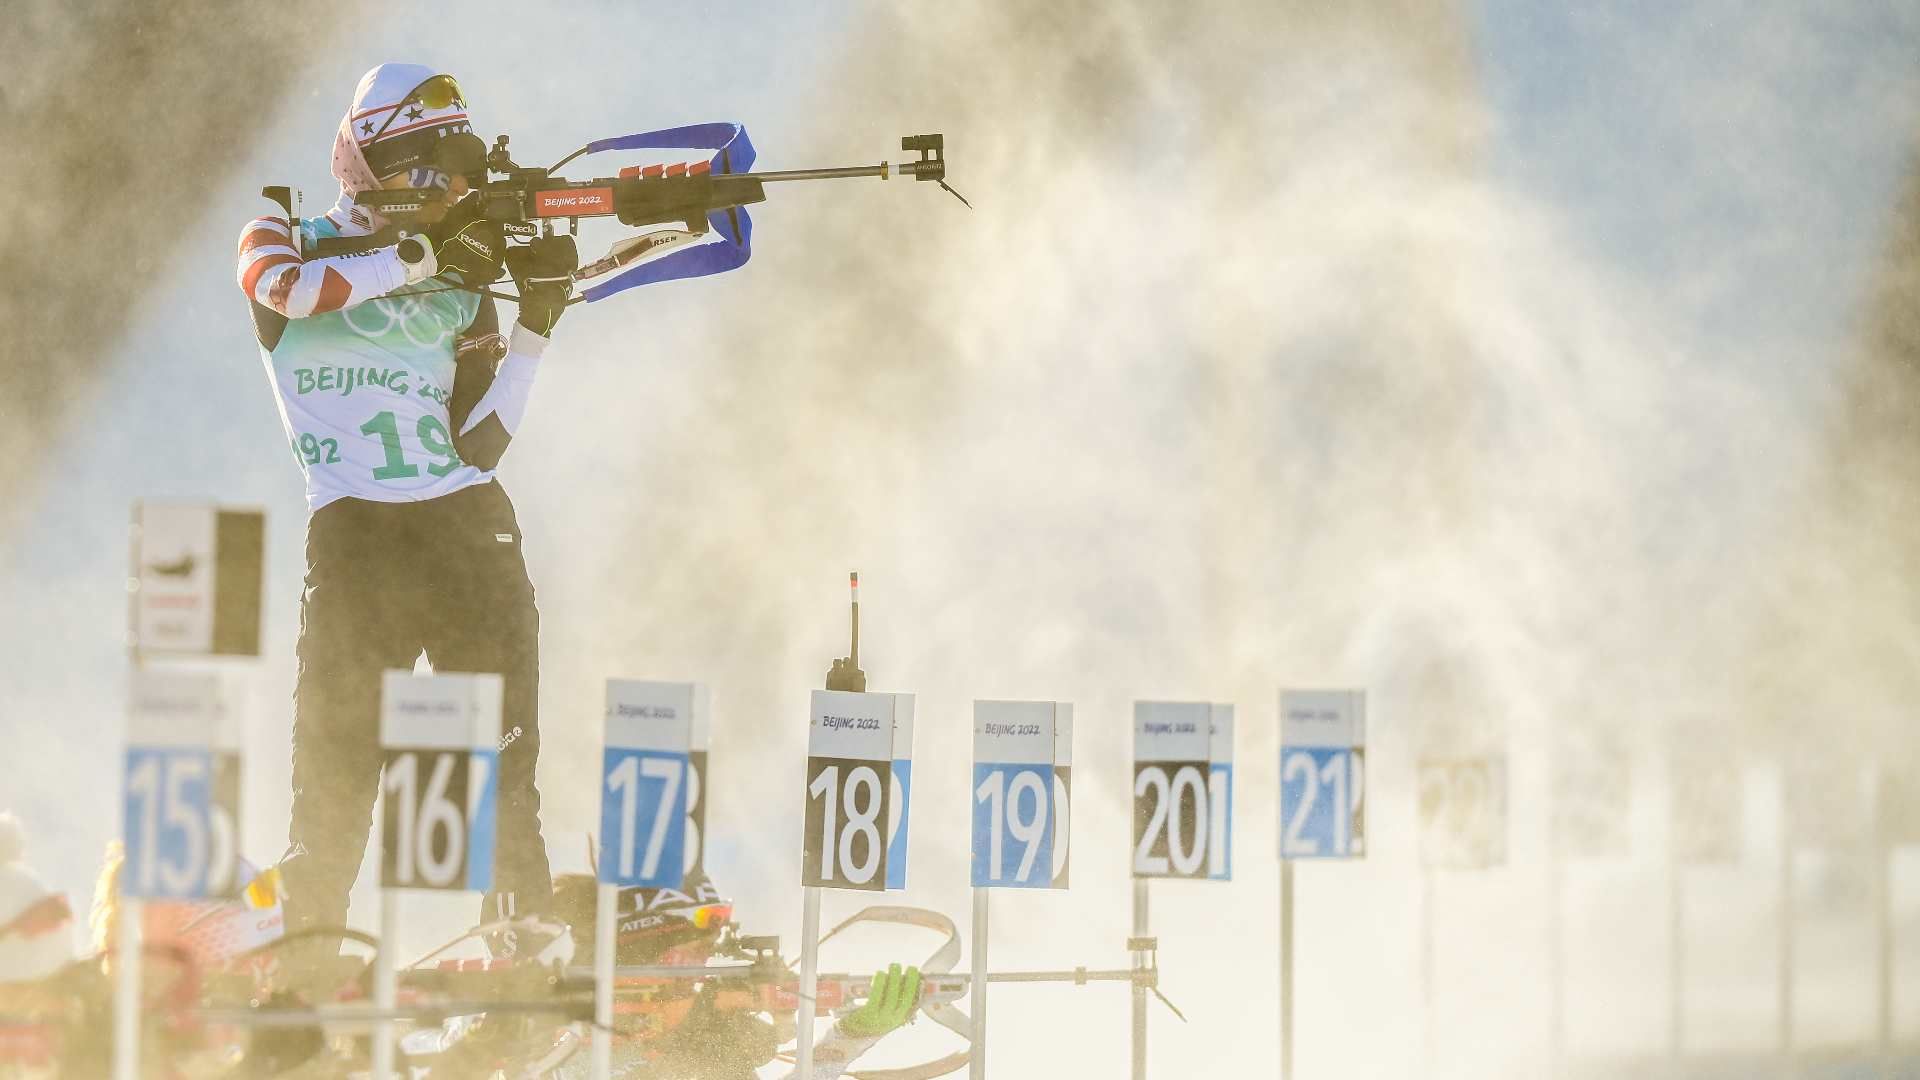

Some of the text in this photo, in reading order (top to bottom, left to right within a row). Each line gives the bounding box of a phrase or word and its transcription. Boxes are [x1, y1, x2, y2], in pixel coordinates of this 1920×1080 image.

[544, 196, 603, 208] BEIJING 2022
[652, 235, 677, 247] RSEN
[294, 366, 409, 396] BEIJING
[823, 715, 854, 731] BEIJING
[856, 717, 881, 731] 2022
[985, 722, 1041, 737] BEIJING 2022
[128, 760, 200, 894] 15
[384, 753, 466, 886] 16
[607, 755, 683, 880] 17
[808, 765, 882, 884] 18
[975, 769, 1049, 882] 19
[1133, 766, 1208, 875] 20
[1282, 751, 1350, 855] 21
